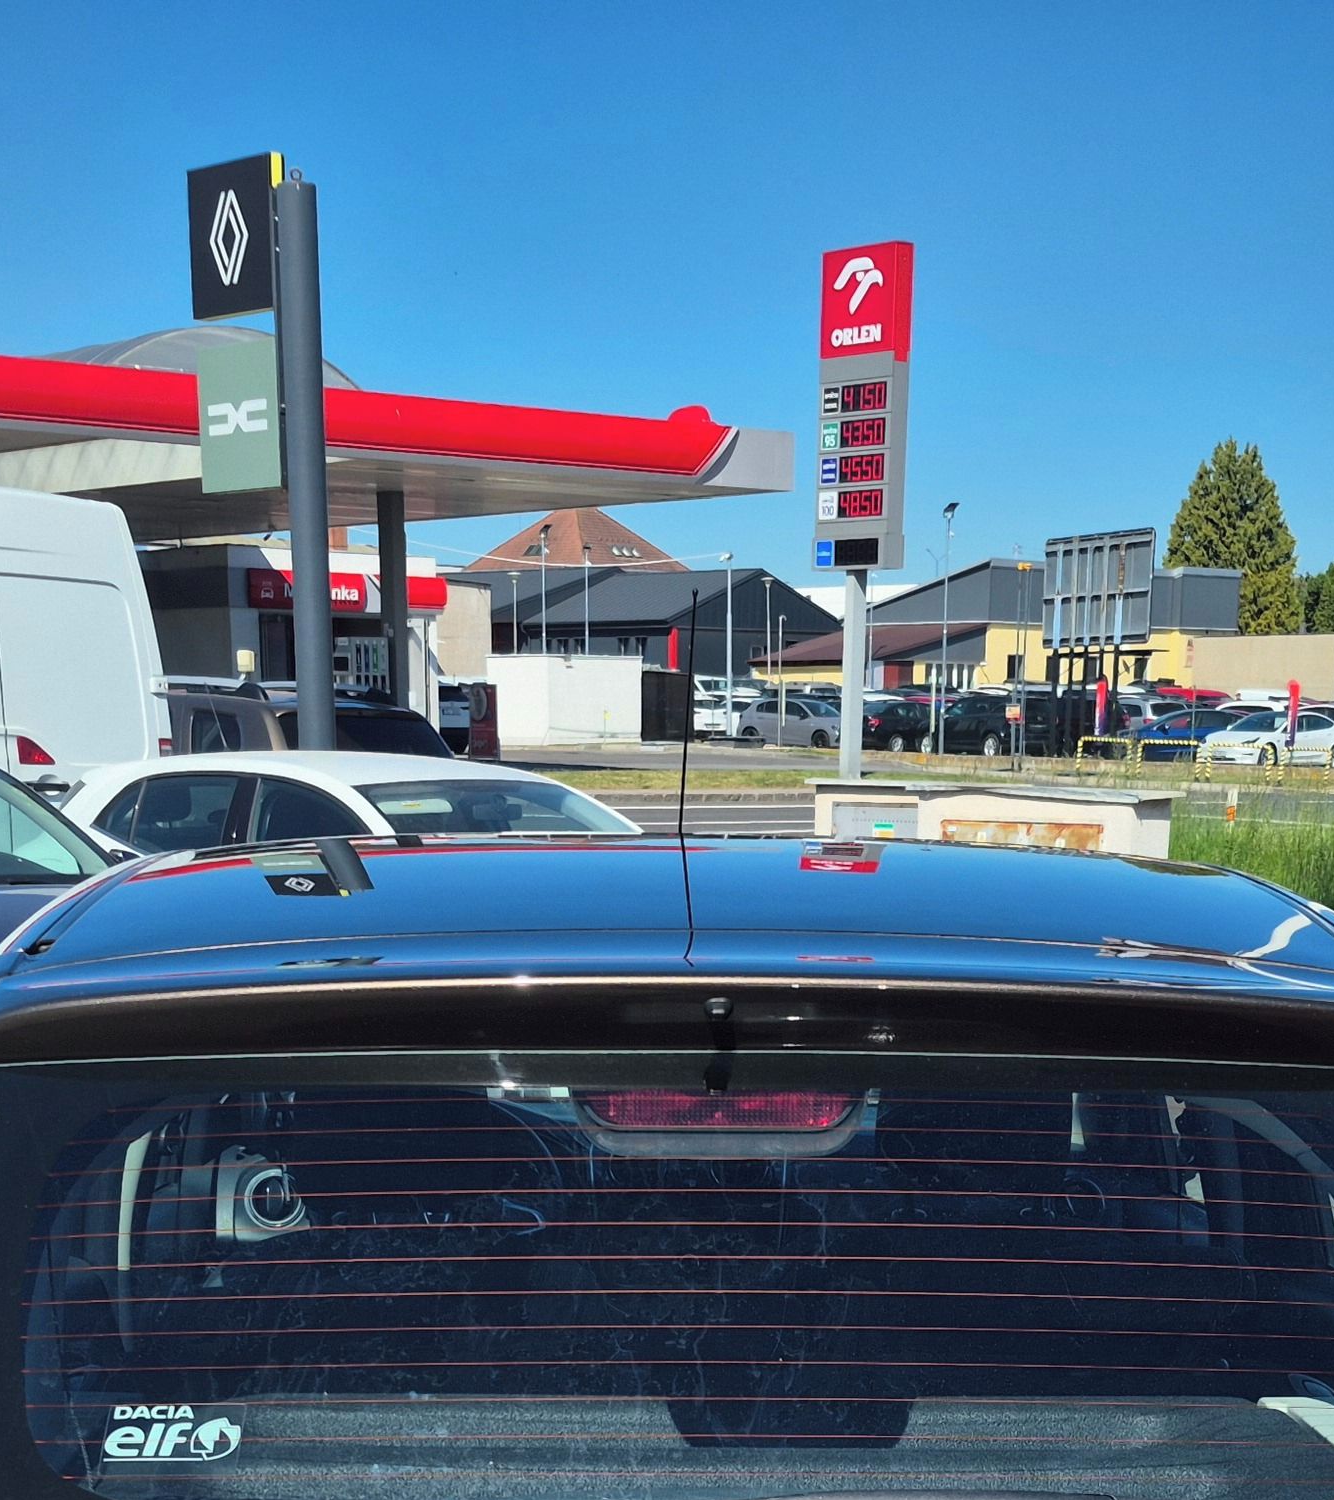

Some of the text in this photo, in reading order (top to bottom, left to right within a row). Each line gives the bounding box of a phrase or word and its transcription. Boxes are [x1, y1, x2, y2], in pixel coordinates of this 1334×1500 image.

[831, 323, 882, 347] ORLEN
[844, 383, 885, 411] 4150
[824, 435, 836, 447] 95
[843, 420, 884, 447] 4350
[842, 455, 883, 481] 4550
[821, 506, 835, 517] 100
[840, 491, 881, 516] 4850
[113, 1405, 195, 1420] DACIA
[104, 1422, 193, 1457] elf
